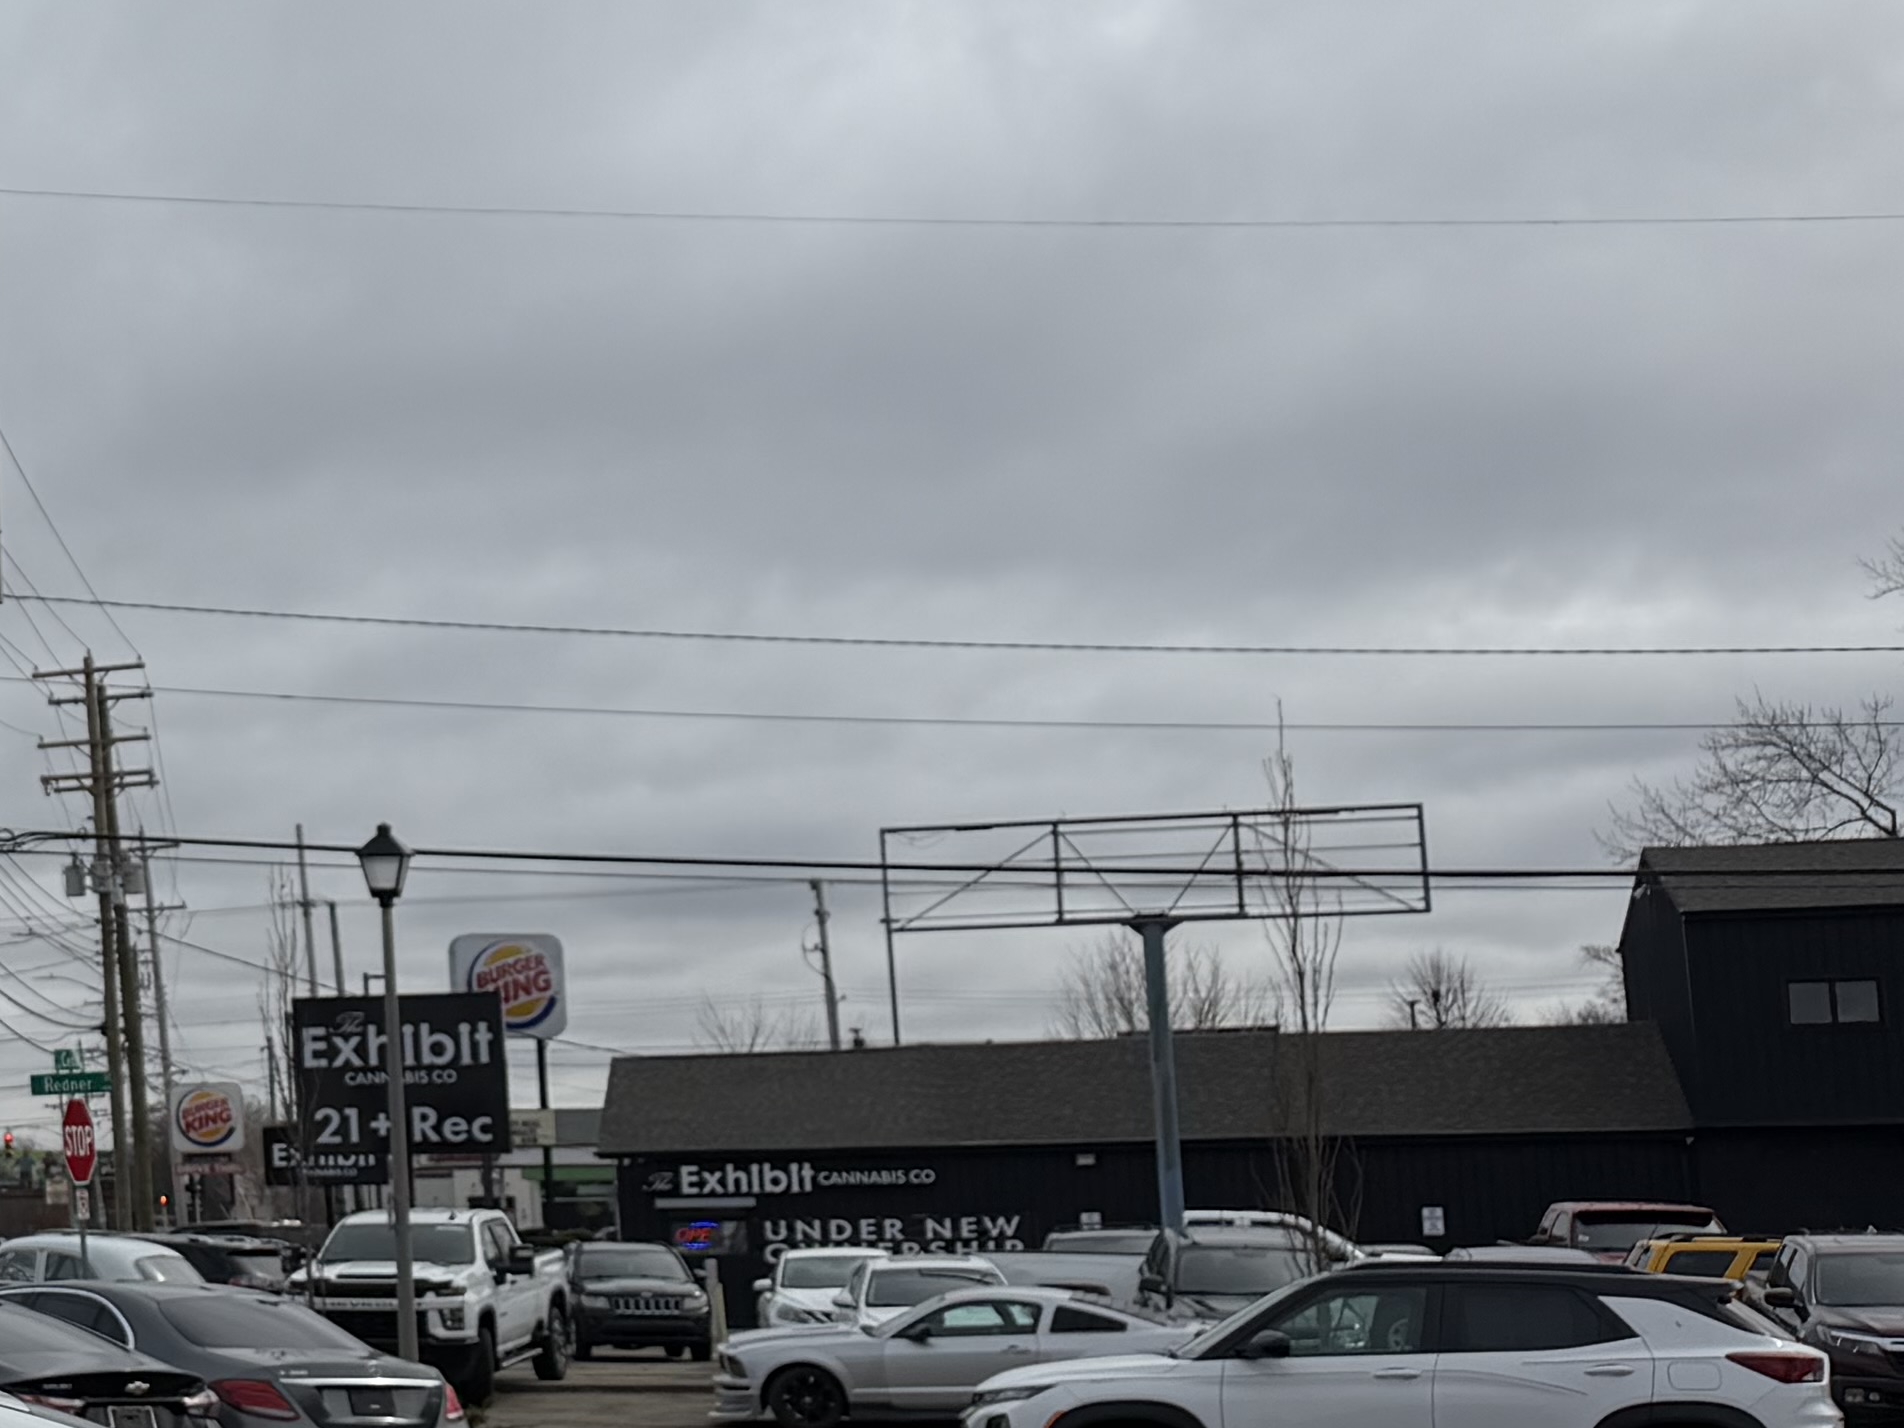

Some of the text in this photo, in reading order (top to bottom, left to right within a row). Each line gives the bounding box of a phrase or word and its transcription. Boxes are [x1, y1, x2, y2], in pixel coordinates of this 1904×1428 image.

[476, 953, 546, 989] BURGER
[301, 1021, 494, 1069] Exhibit
[44, 1076, 92, 1092] Redner
[344, 1068, 458, 1087] CANNBIS CO
[184, 1108, 232, 1134] KING
[410, 1105, 494, 1144] Rec
[65, 1125, 92, 1157] STOP
[678, 1162, 816, 1195] Exhibit
[816, 1169, 907, 1186] CANNABIS
[908, 1168, 937, 1184] CO
[763, 1215, 1022, 1242] UNDER NEW
